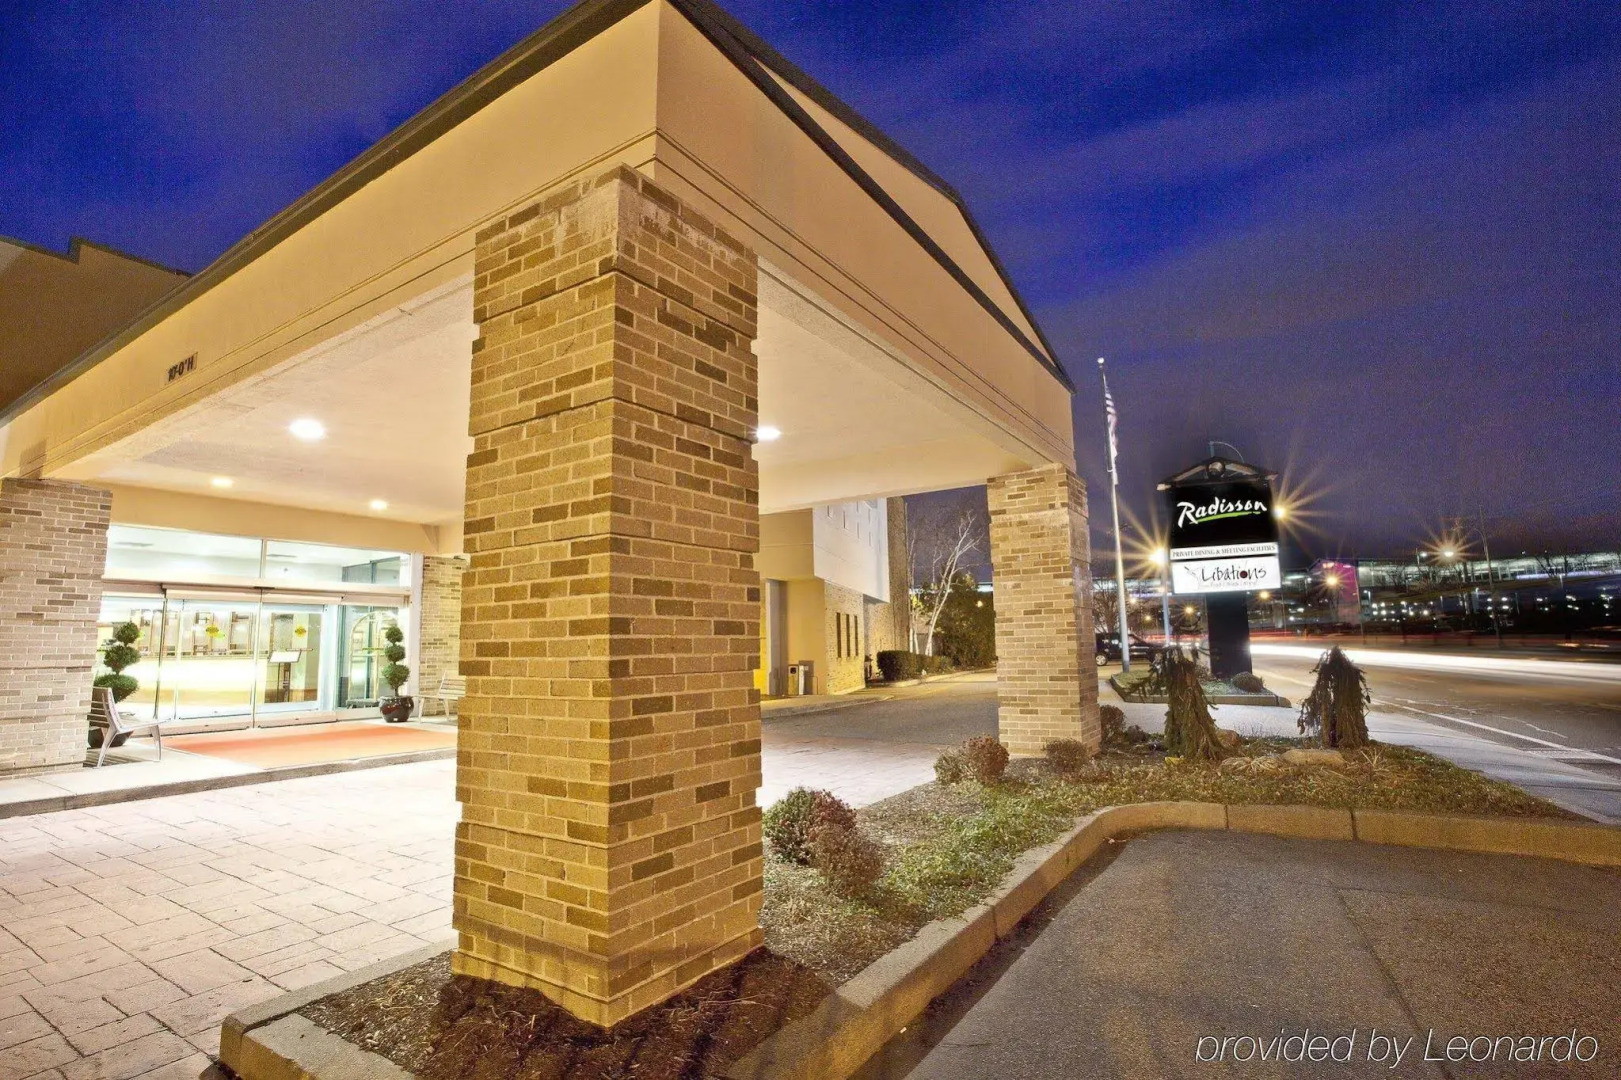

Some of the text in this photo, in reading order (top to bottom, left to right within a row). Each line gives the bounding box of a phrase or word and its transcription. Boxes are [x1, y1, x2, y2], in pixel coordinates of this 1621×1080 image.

[1177, 497, 1268, 528] Radisson
[1173, 550, 1194, 558] PRIVATE
[1201, 564, 1267, 582] Libations
